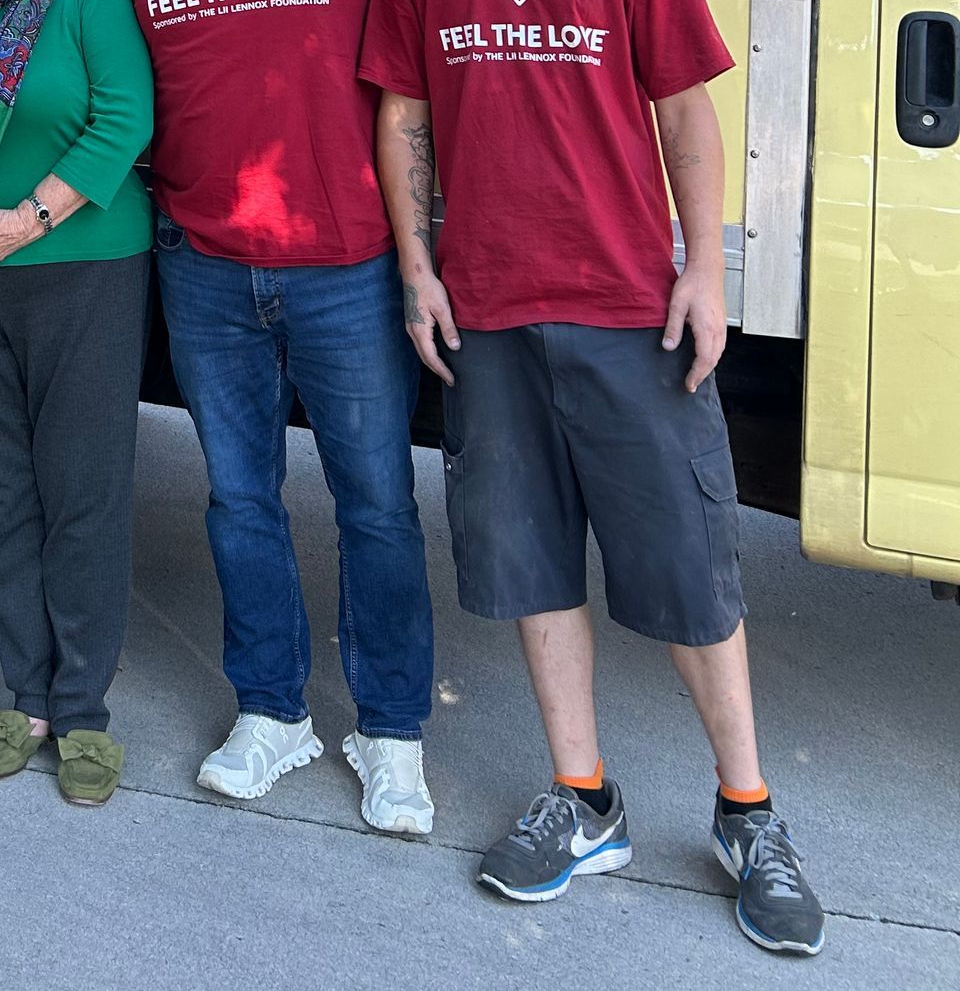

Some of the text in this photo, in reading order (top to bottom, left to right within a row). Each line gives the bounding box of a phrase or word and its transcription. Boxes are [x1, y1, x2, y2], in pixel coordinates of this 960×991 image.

[152, 13, 187, 30] Sponsored
[187, 12, 197, 22] by
[198, 9, 216, 18] THE
[230, 0, 268, 13] LENNOX
[439, 23, 489, 51] FEEL
[490, 23, 543, 48] THE
[472, 51, 483, 63] by
[484, 52, 504, 61] THE
[518, 51, 557, 62] LENNOX
